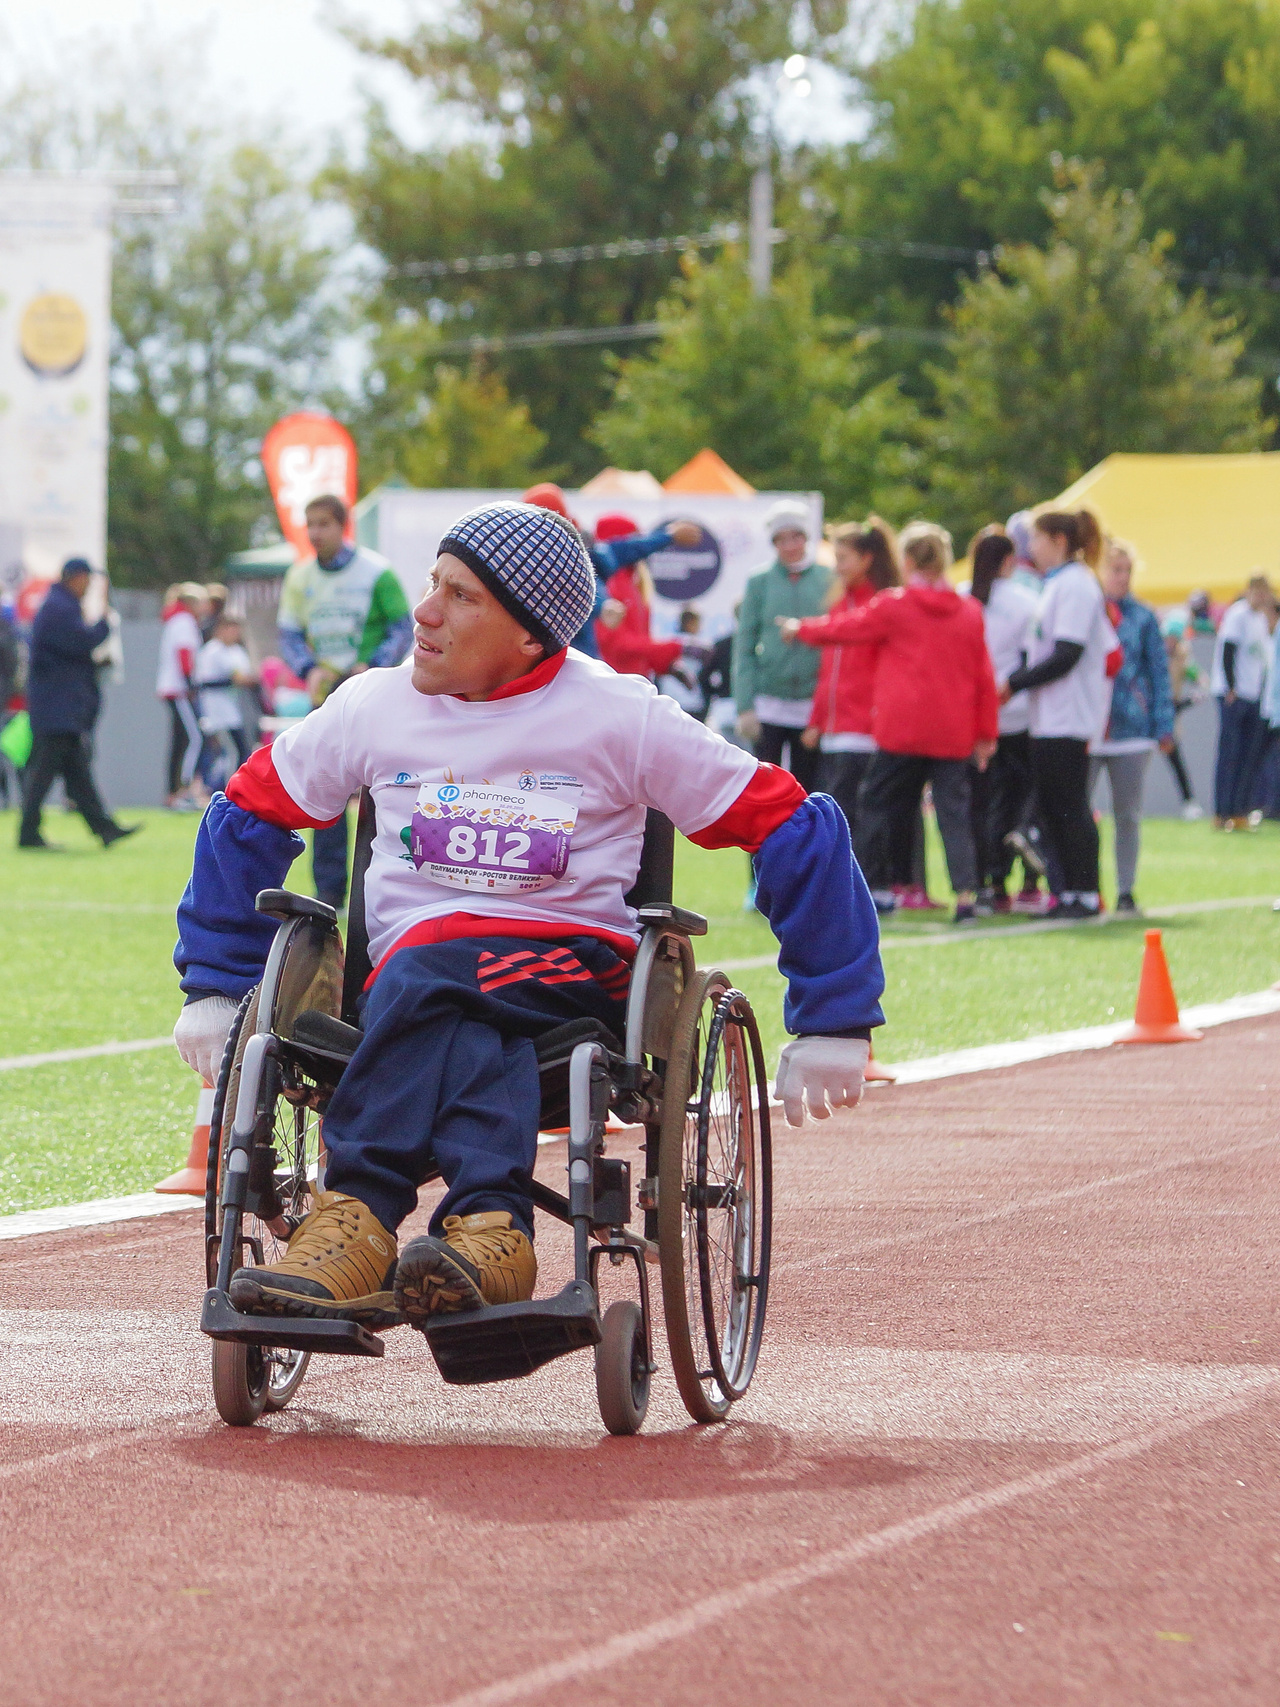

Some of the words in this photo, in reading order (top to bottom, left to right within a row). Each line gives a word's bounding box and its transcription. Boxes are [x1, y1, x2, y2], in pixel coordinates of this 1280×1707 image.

[462, 789, 526, 805] pharmeco
[445, 825, 531, 869] 812
[430, 863, 478, 876] ПОЛУМАРАФОН
